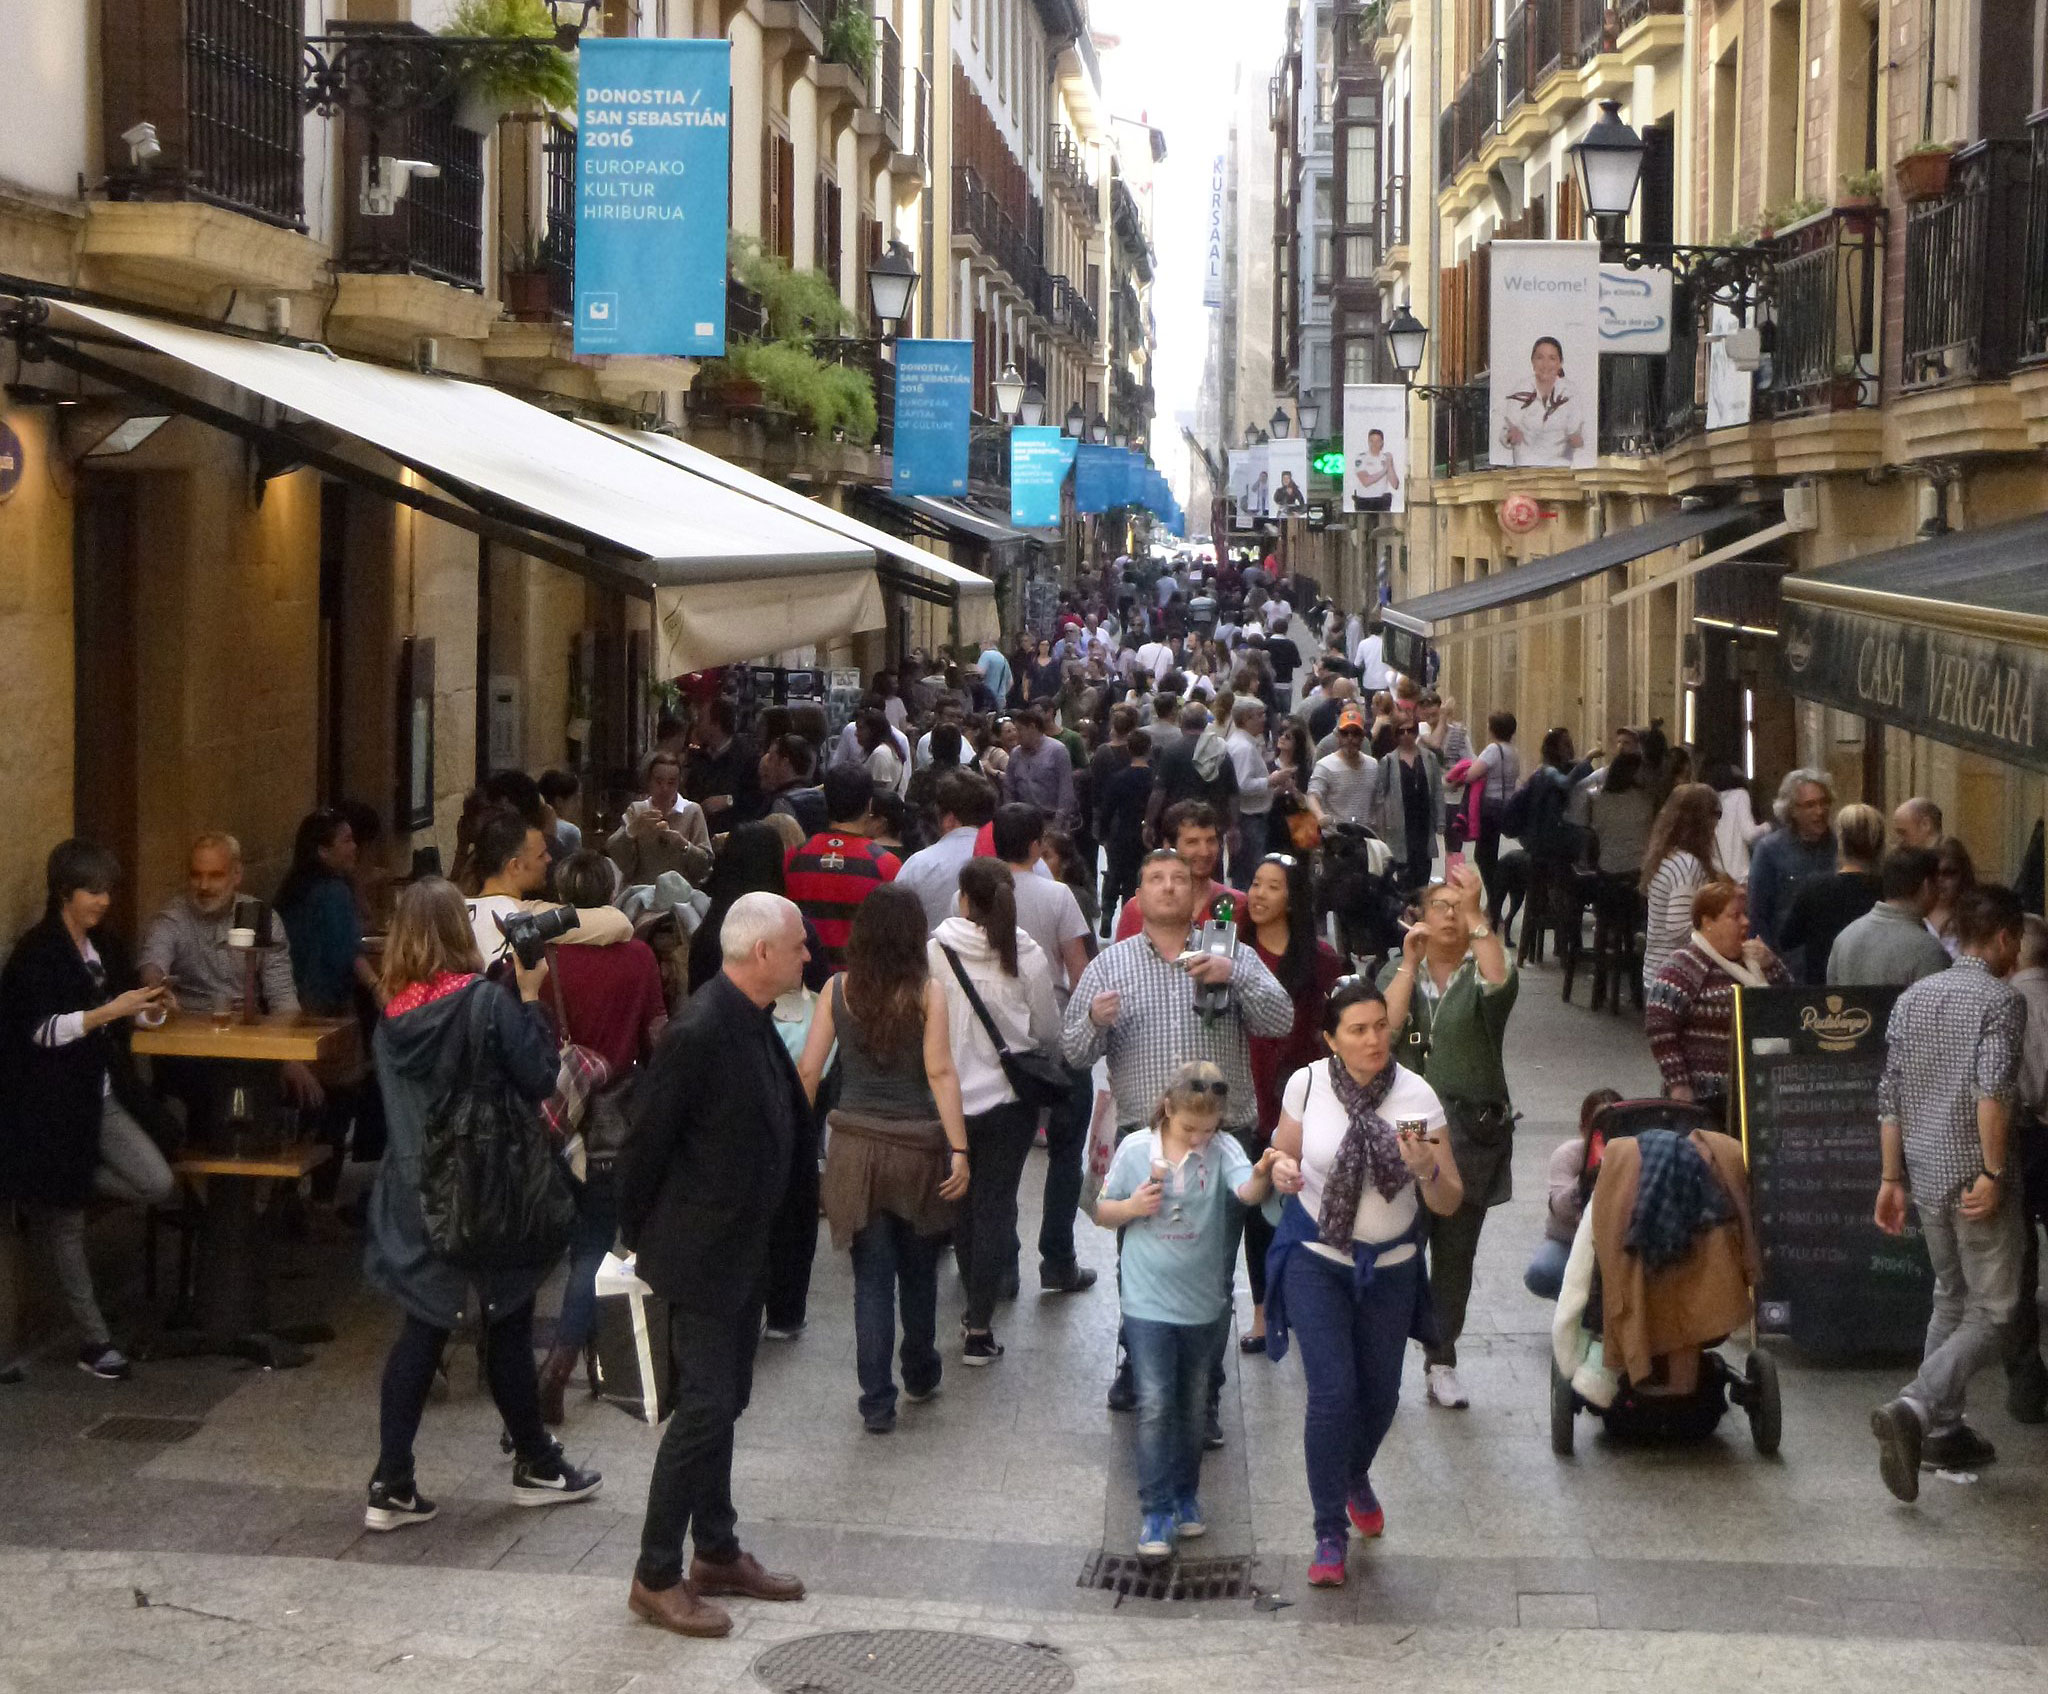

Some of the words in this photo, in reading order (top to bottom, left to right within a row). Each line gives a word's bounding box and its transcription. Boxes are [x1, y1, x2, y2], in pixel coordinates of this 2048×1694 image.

[585, 88, 685, 104] DONOSTIA
[690, 88, 702, 106] /
[585, 110, 622, 125] SAN
[627, 107, 726, 126] SEBASTIÁN
[585, 129, 634, 147] 2016
[585, 160, 685, 175] EUROPAKO
[584, 182, 655, 197] KULTUR
[584, 204, 685, 221] HIRIBURUA
[1209, 159, 1223, 277] KURSAAL
[1503, 275, 1588, 293] Welcome!
[900, 364, 950, 372] DONOSTIA
[899, 384, 925, 393] 2016
[1857, 635, 1905, 708] CASA
[1928, 648, 2035, 748] VERGARA
